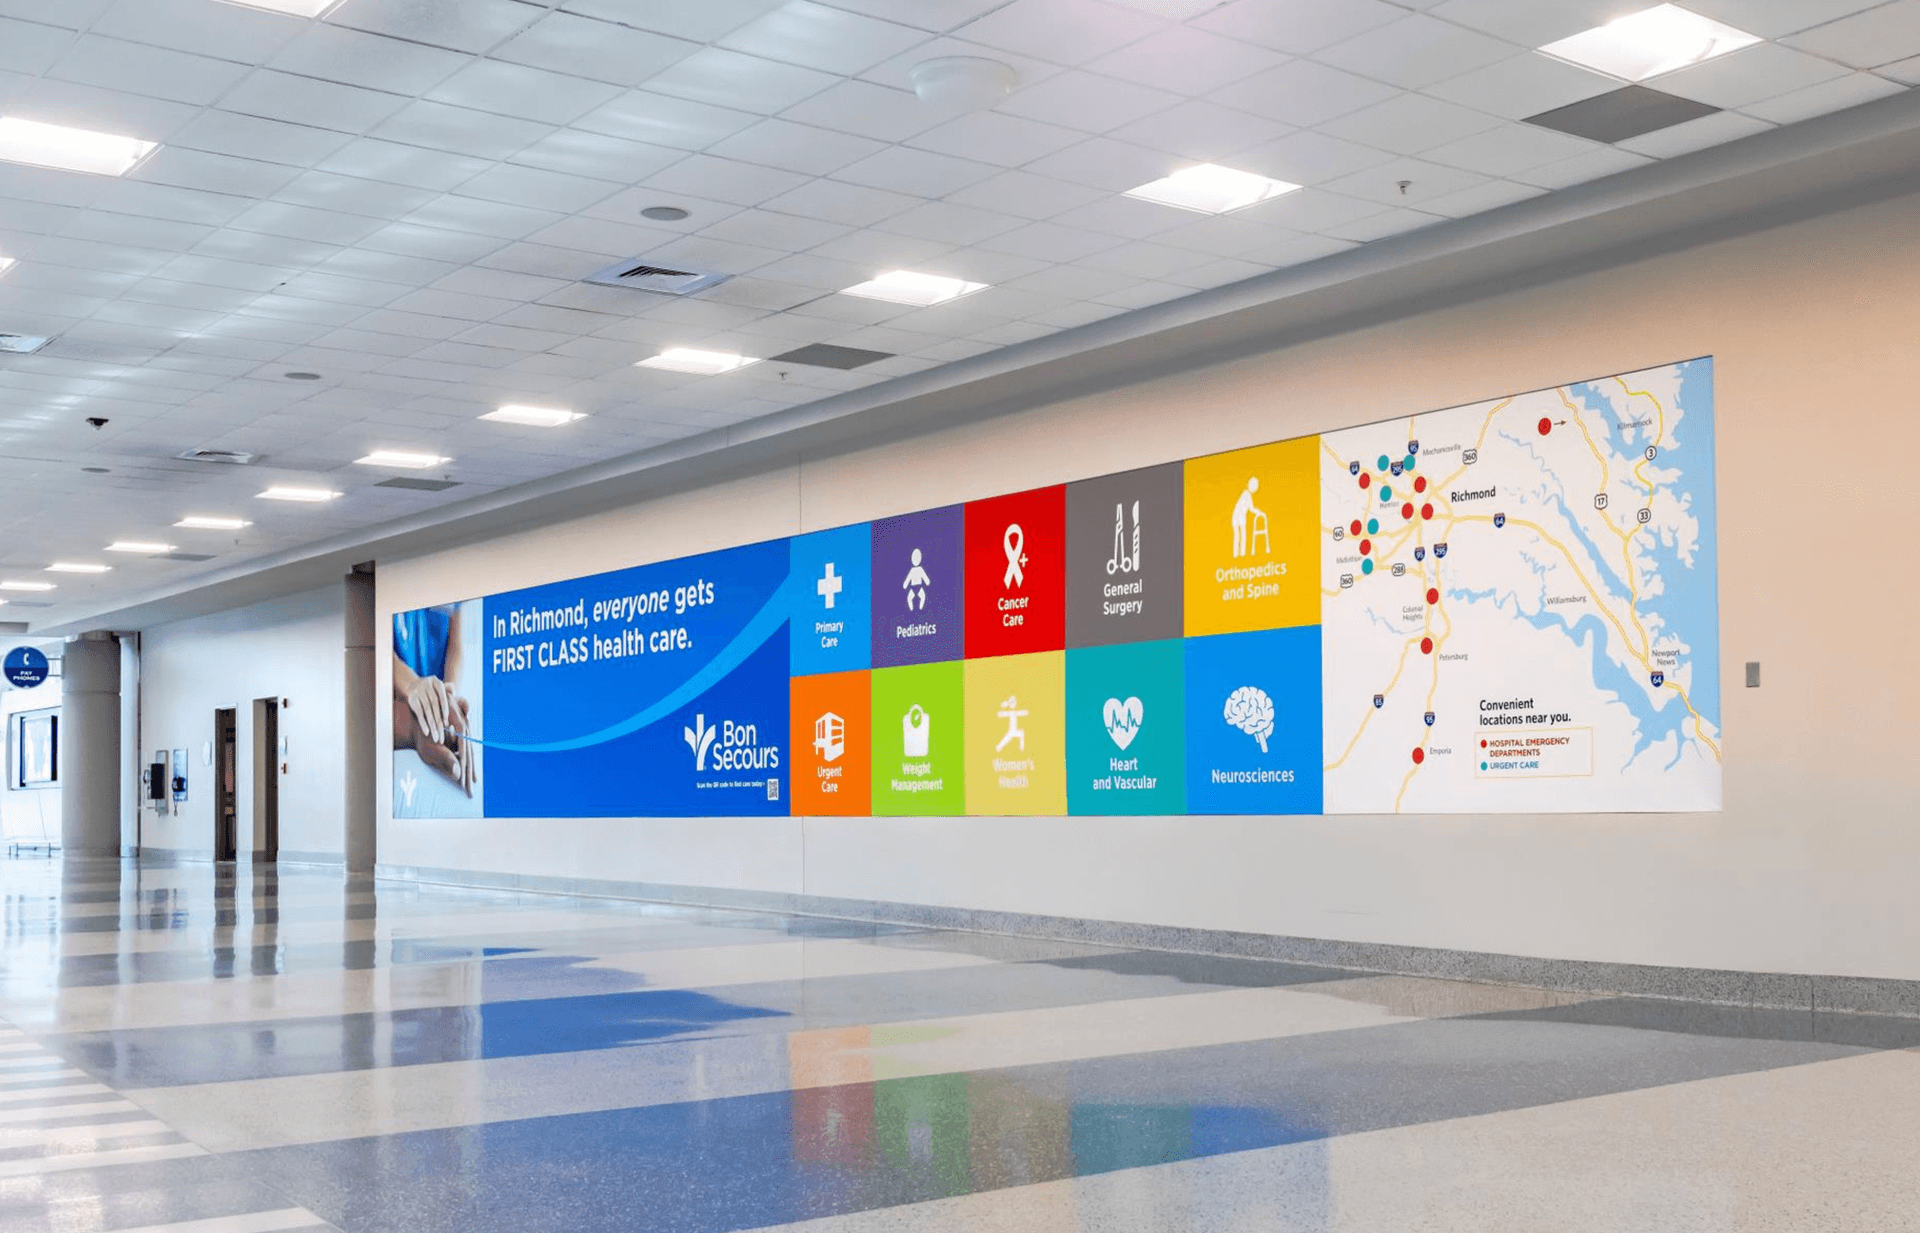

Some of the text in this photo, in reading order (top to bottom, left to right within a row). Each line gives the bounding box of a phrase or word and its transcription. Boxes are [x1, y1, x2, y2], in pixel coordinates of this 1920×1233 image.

[1451, 485, 1497, 503] Richmond
[1215, 561, 1287, 583] Orthopedics
[1103, 578, 1143, 598] General
[1222, 582, 1279, 601] and Spine
[493, 578, 715, 639] In Richmond, everyone gets
[998, 596, 1030, 611] Cancer
[1103, 599, 1143, 616] Surgery
[815, 621, 844, 634] Primary
[1003, 614, 1024, 627] Care
[896, 622, 937, 638] Pediatrics
[821, 636, 838, 648] Care
[493, 626, 693, 674] FIRST CLASS health care.
[1439, 653, 1469, 661] Petersburg
[1652, 649, 1680, 658] Newport
[1657, 658, 1675, 667] News
[1479, 698, 1534, 711] Convenient
[1479, 713, 1572, 726] locations near you.
[723, 720, 757, 748] Bon
[1489, 737, 1571, 748] HOSPITAL EMERGENCY
[712, 742, 780, 771] Secours
[1429, 747, 1452, 756] Emporia
[1489, 748, 1541, 758] DEPARTMENTS
[902, 762, 931, 777] Weight
[1109, 757, 1138, 771] Heart
[1489, 761, 1540, 770] URGENT CARE
[817, 766, 842, 780] Urgent
[1211, 767, 1295, 784] Neurosciences
[821, 781, 838, 793] Care
[891, 778, 943, 793] Management
[1092, 775, 1157, 790] and Vascular
